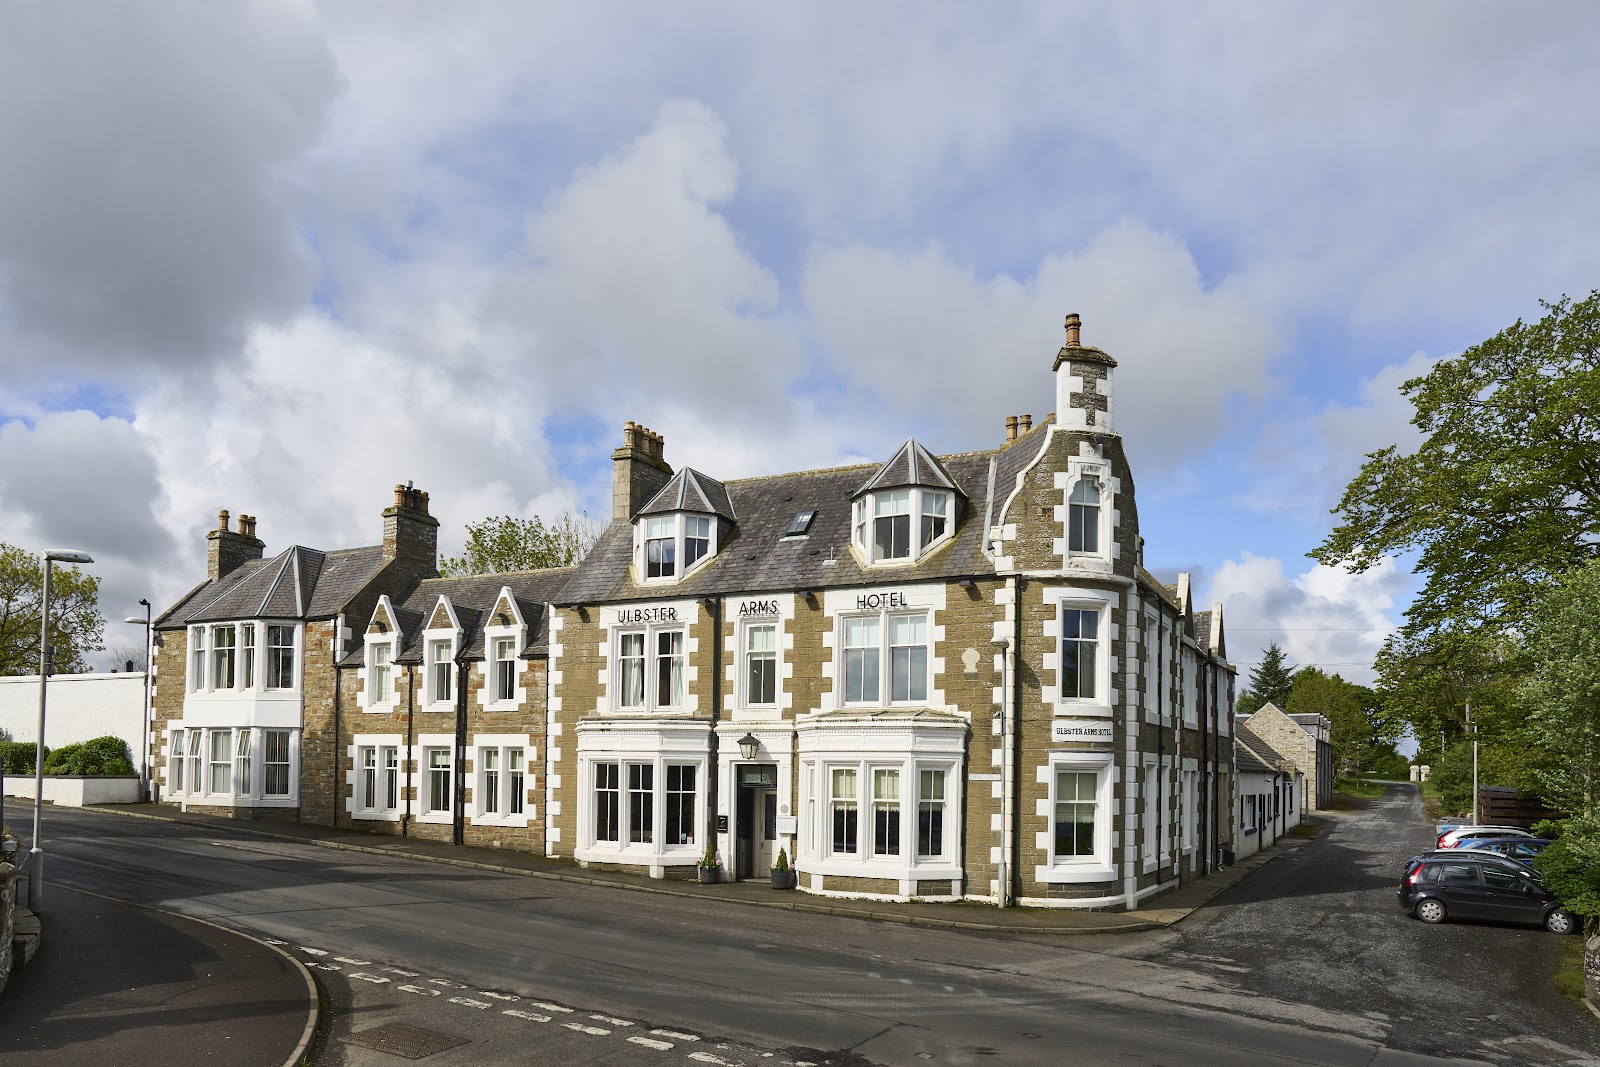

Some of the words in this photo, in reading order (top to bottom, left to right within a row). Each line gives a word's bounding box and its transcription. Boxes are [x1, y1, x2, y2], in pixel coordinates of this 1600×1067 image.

[618, 606, 676, 623] ULBSTER
[739, 600, 778, 615] ARMS
[857, 592, 907, 609] HOTEL
[1056, 727, 1082, 735] ULBSTER
[1083, 728, 1097, 736] ARMS
